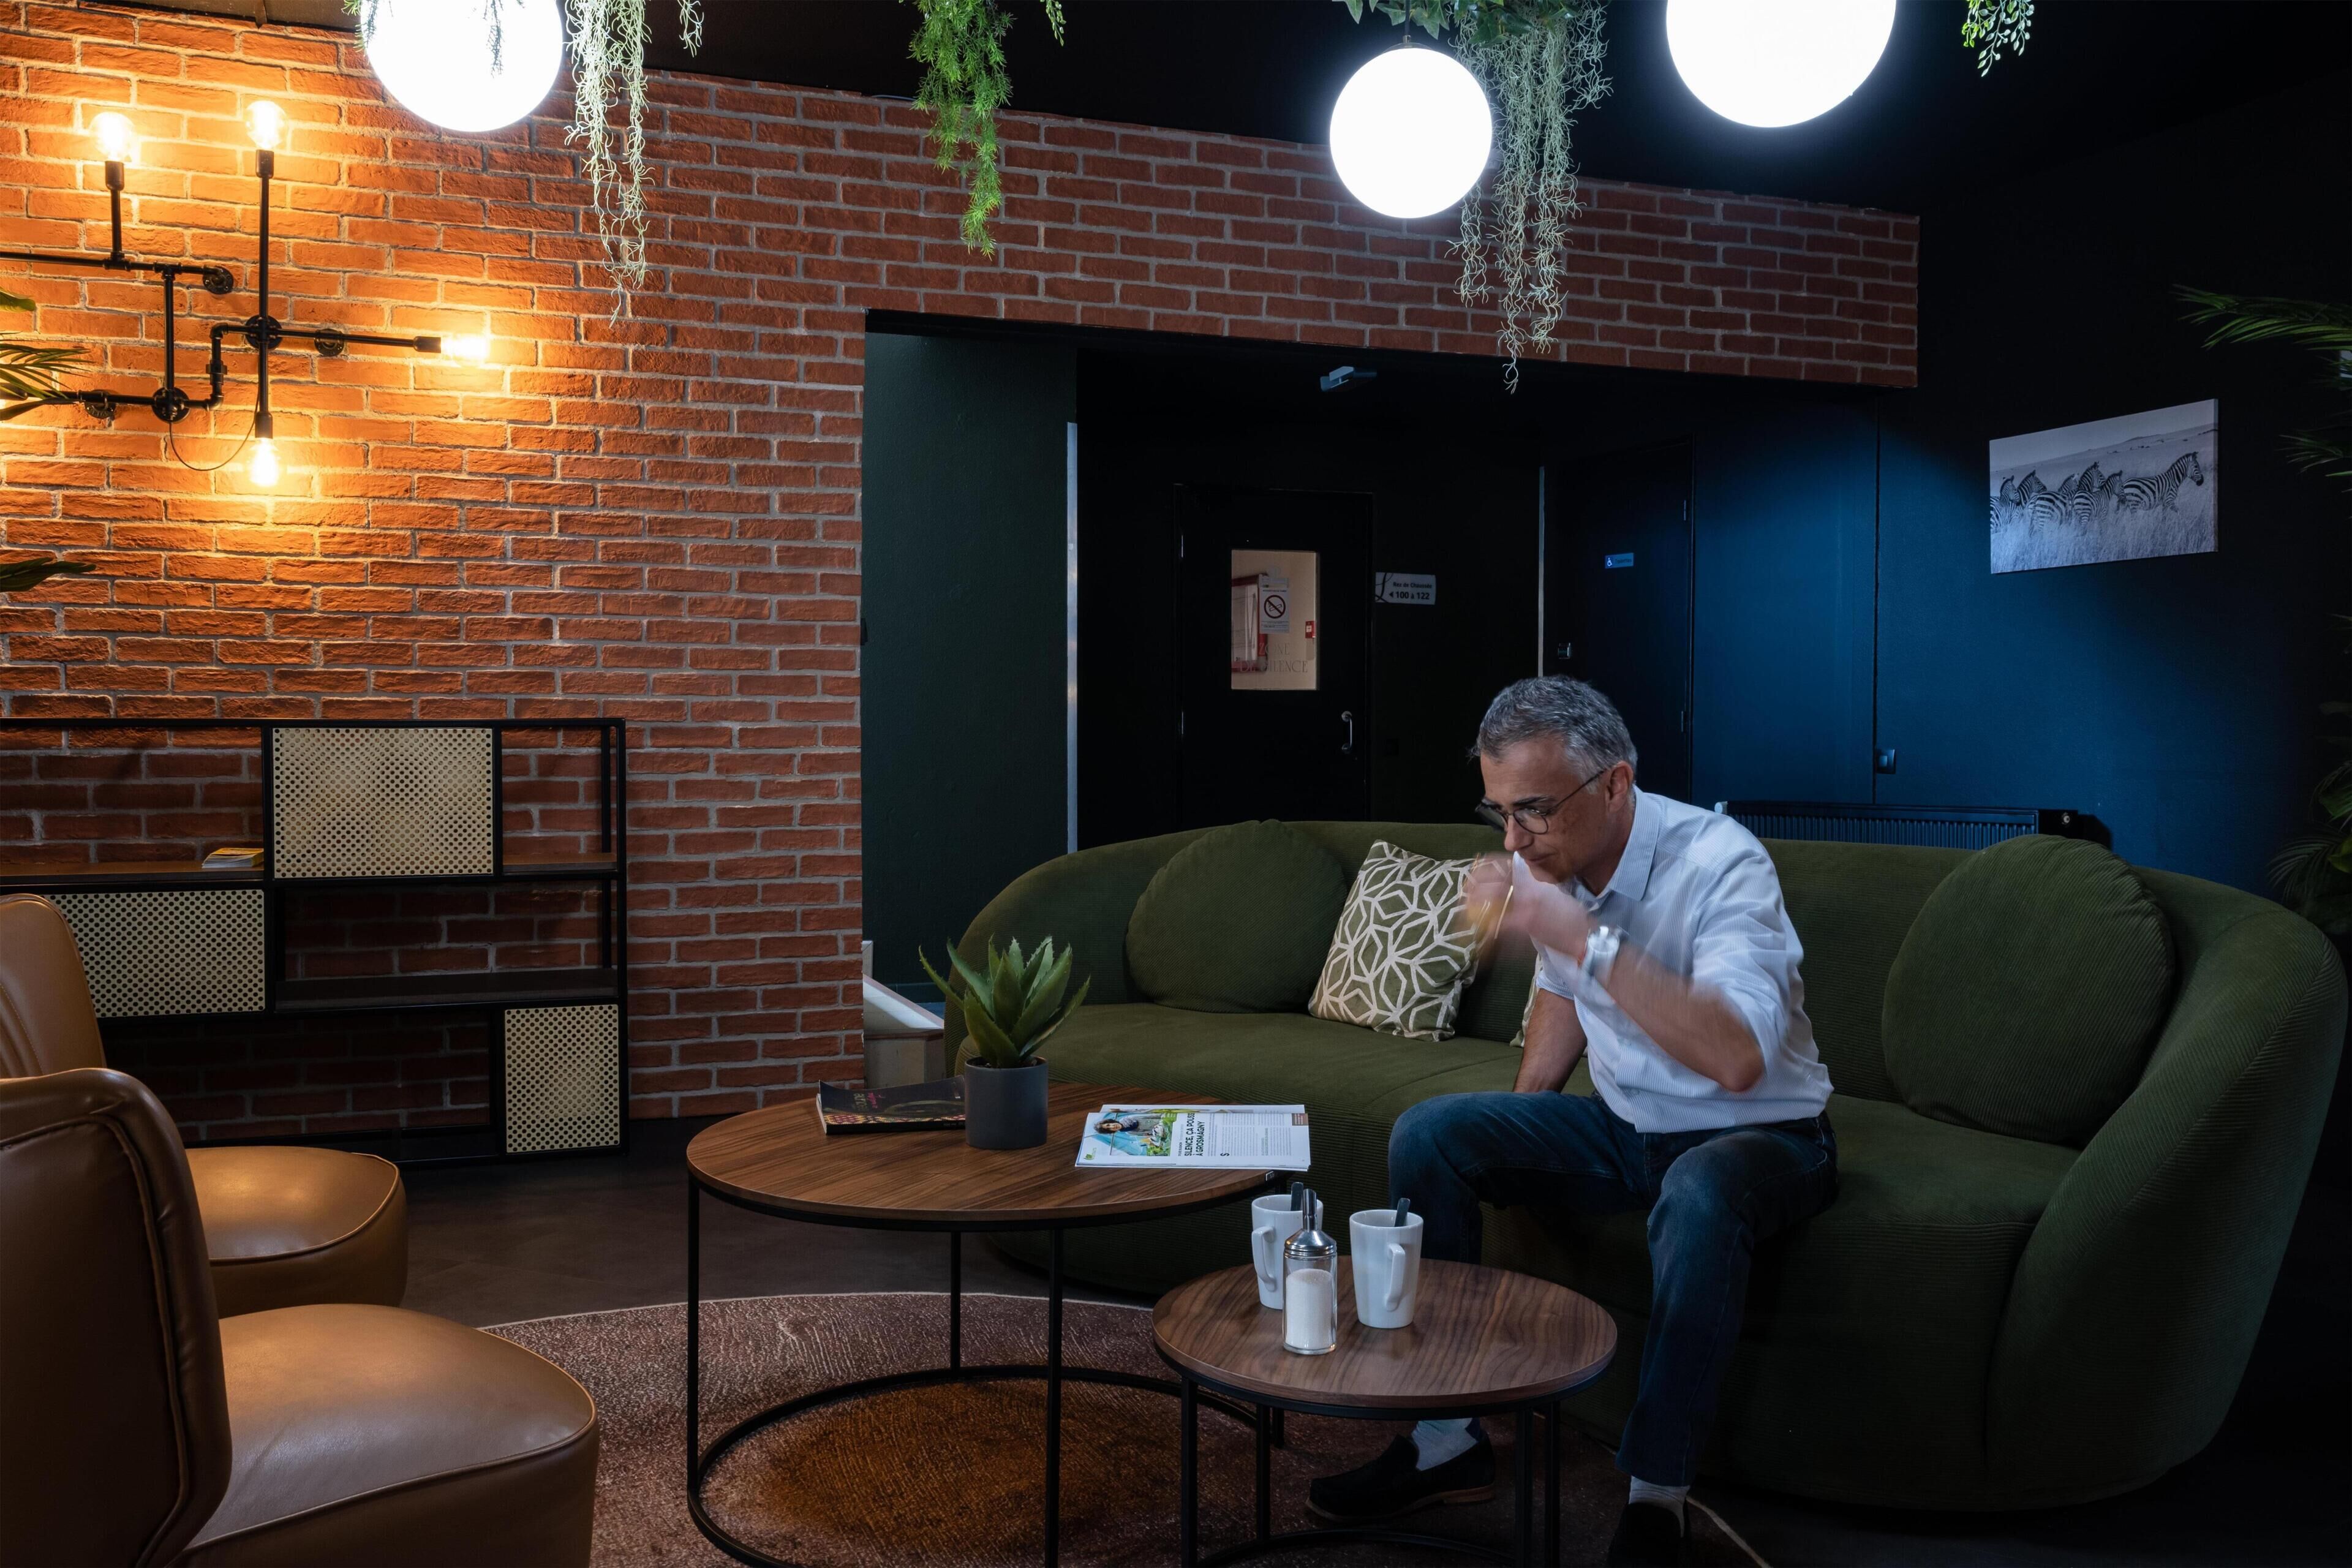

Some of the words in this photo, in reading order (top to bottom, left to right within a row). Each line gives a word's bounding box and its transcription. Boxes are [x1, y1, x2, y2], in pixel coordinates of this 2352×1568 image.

[1259, 643, 1290, 655] ZONE
[1240, 661, 1256, 673] DE
[1262, 660, 1308, 673] SILENCE
[1186, 1113, 1195, 1127] POUSS
[1196, 1121, 1205, 1153] GROSMAGNY
[1184, 1136, 1194, 1156] SILENCE,
